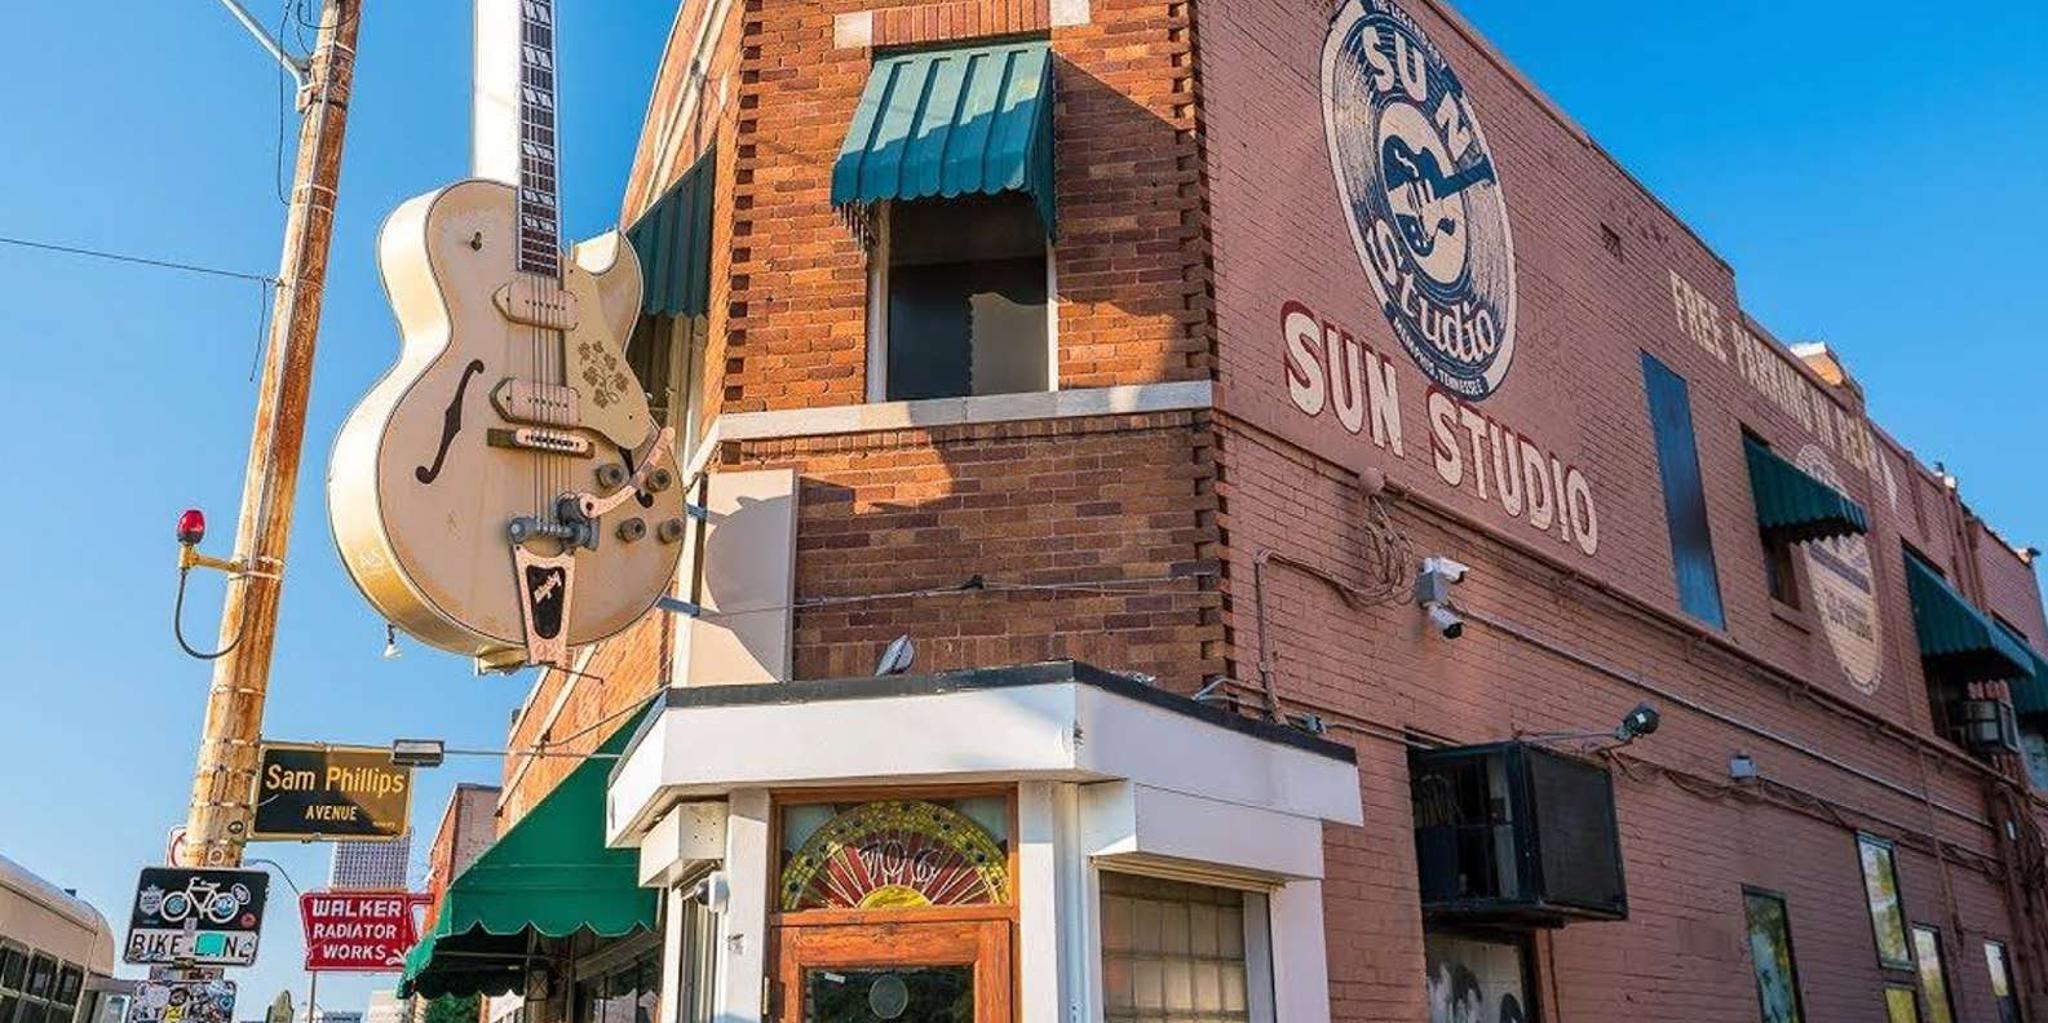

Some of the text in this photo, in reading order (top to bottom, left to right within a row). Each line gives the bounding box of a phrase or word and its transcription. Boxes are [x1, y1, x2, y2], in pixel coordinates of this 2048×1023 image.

[1362, 26, 1472, 162] SUN
[1367, 219, 1495, 363] Studio
[1668, 268, 1727, 364] FREE
[1281, 300, 1597, 556] SUN STUDIO
[266, 764, 405, 798] Sam Phillips
[305, 805, 358, 821] AVENUE
[312, 899, 402, 917] WALKER
[313, 923, 398, 939] RADIATOR
[130, 934, 183, 957] BIKE
[323, 944, 388, 960] WORKS
